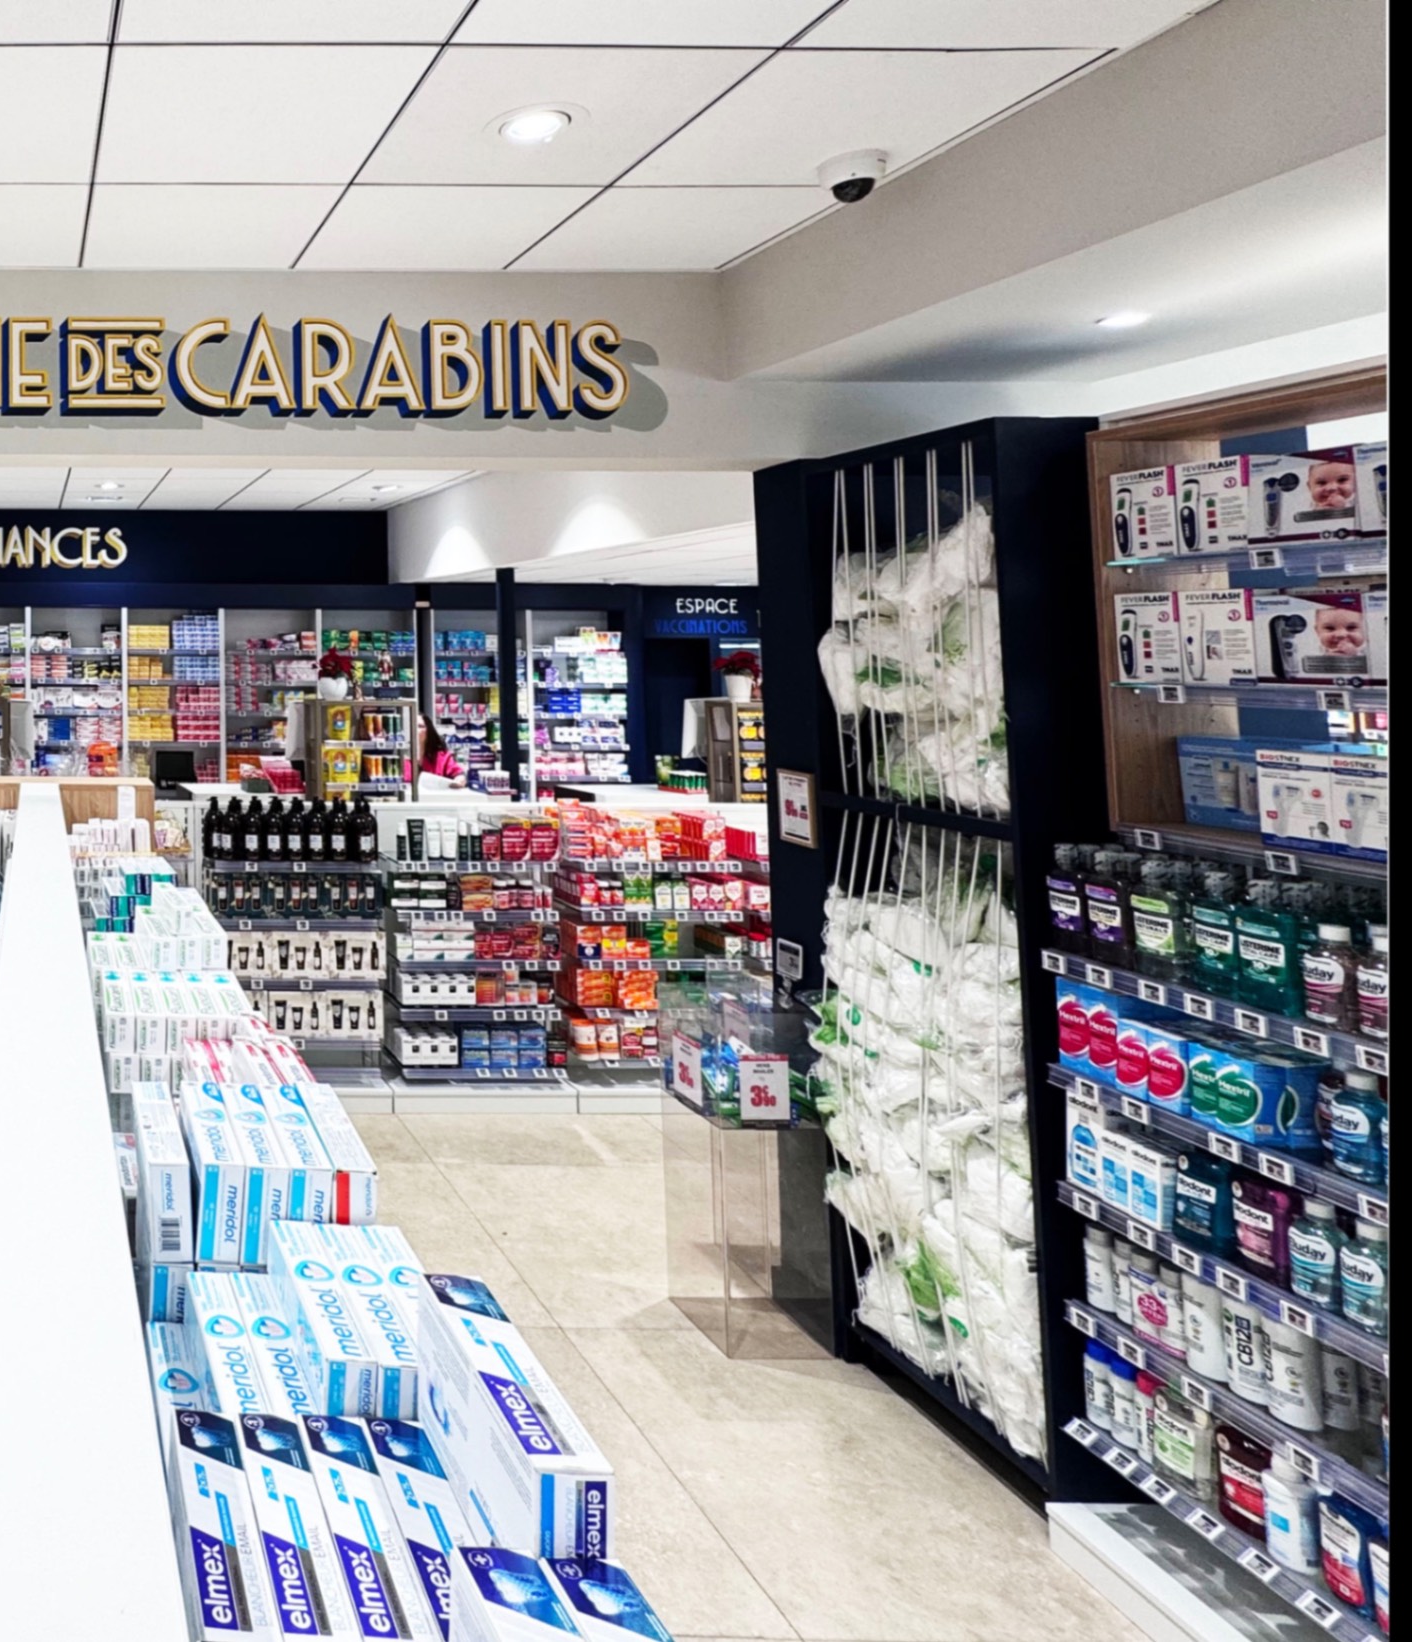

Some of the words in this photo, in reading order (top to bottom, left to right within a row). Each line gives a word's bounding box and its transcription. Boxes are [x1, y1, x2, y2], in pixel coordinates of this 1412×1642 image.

[62, 327, 164, 402] DES
[168, 312, 630, 419] CARABINS
[675, 597, 739, 615] ESPACE
[1058, 1010, 1086, 1025] Hextril
[1089, 1020, 1116, 1036] Hextril
[1149, 1054, 1178, 1072] Hextril
[1219, 1080, 1250, 1098] Hextril
[164, 1172, 173, 1212] meridol
[223, 1184, 238, 1243] meridol
[310, 1285, 363, 1358] meridol
[359, 1289, 416, 1363] meridol
[1237, 1322, 1253, 1367] CB12
[267, 1347, 312, 1416] meridol
[495, 1382, 554, 1452] elmex
[236, 1523, 253, 1557] EMAIL
[587, 1489, 605, 1558] elmex
[201, 1543, 233, 1624] elmex
[277, 1547, 312, 1629] elmex
[348, 1550, 392, 1633] elmex
